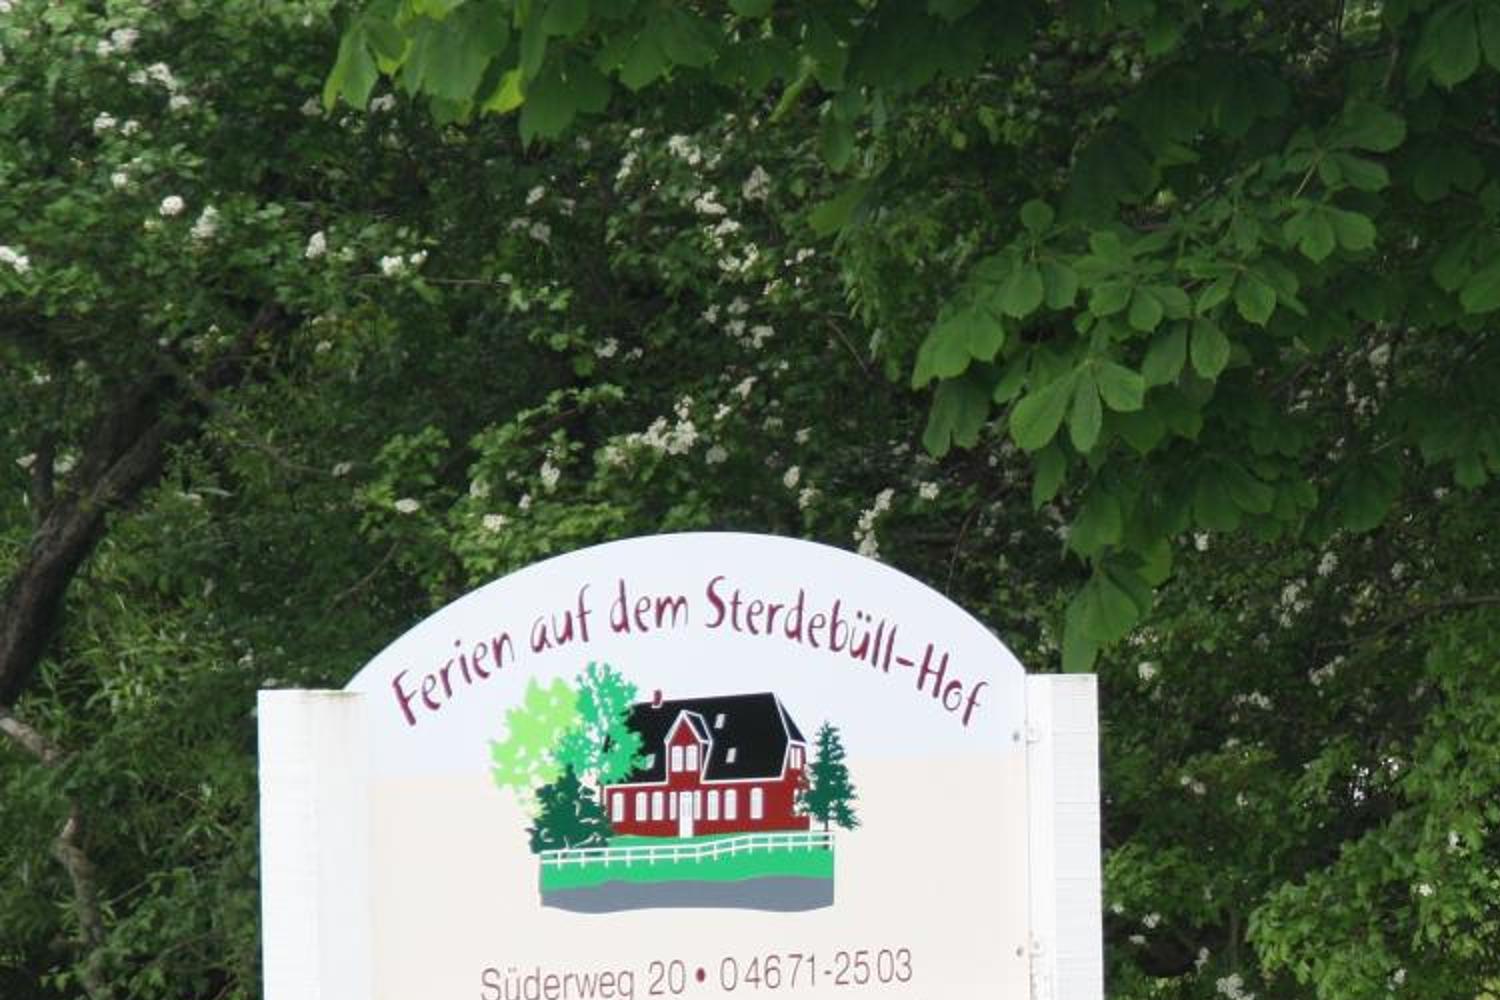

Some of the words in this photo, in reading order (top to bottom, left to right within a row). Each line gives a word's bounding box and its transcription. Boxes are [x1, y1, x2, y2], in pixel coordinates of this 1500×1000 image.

[392, 632, 515, 727] Ferien
[530, 583, 592, 652] auf
[609, 579, 689, 633] dem
[704, 574, 990, 726] Sterdebüll-Hof
[648, 959, 686, 996] 20
